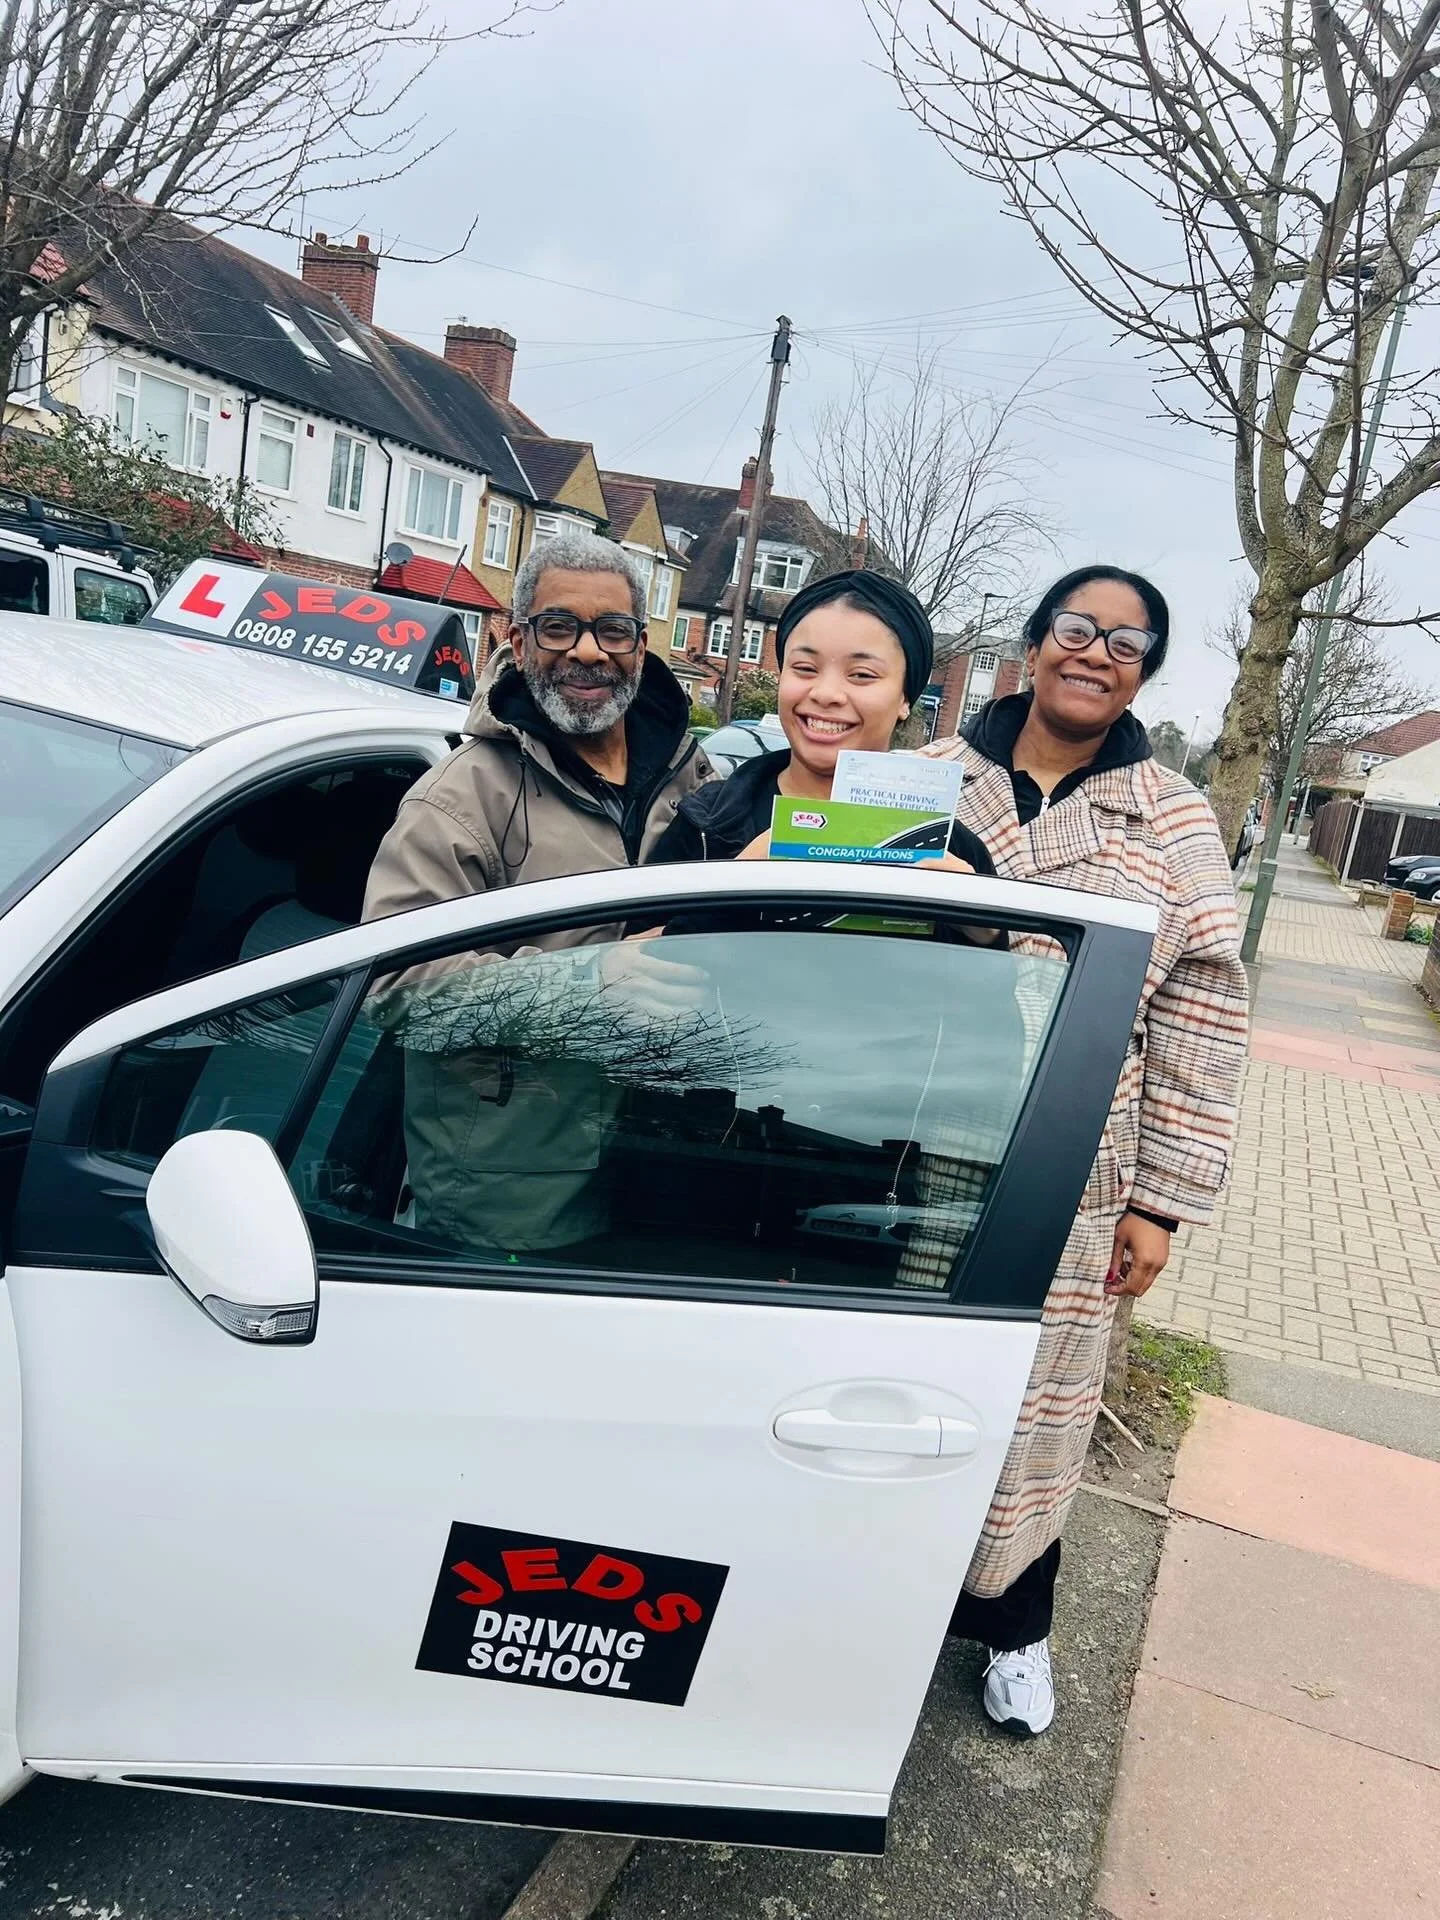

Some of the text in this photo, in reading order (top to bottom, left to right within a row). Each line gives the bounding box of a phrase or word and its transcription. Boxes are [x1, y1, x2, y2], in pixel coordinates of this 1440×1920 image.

[179, 573, 225, 619] L
[258, 587, 427, 646] JEDS
[234, 619, 297, 650] 0808
[301, 634, 344, 662] 155
[349, 644, 414, 676] 5214
[434, 646, 470, 676] JEDS
[793, 814, 820, 824] JEDS
[850, 787, 939, 806] PRACTICAL DRIVING
[850, 795, 867, 804] TEST
[807, 846, 914, 860] CONGRATULATIONS
[451, 1548, 702, 1633] JEDS
[473, 1609, 645, 1660] DRIVING
[467, 1641, 631, 1690] SCHOOL
